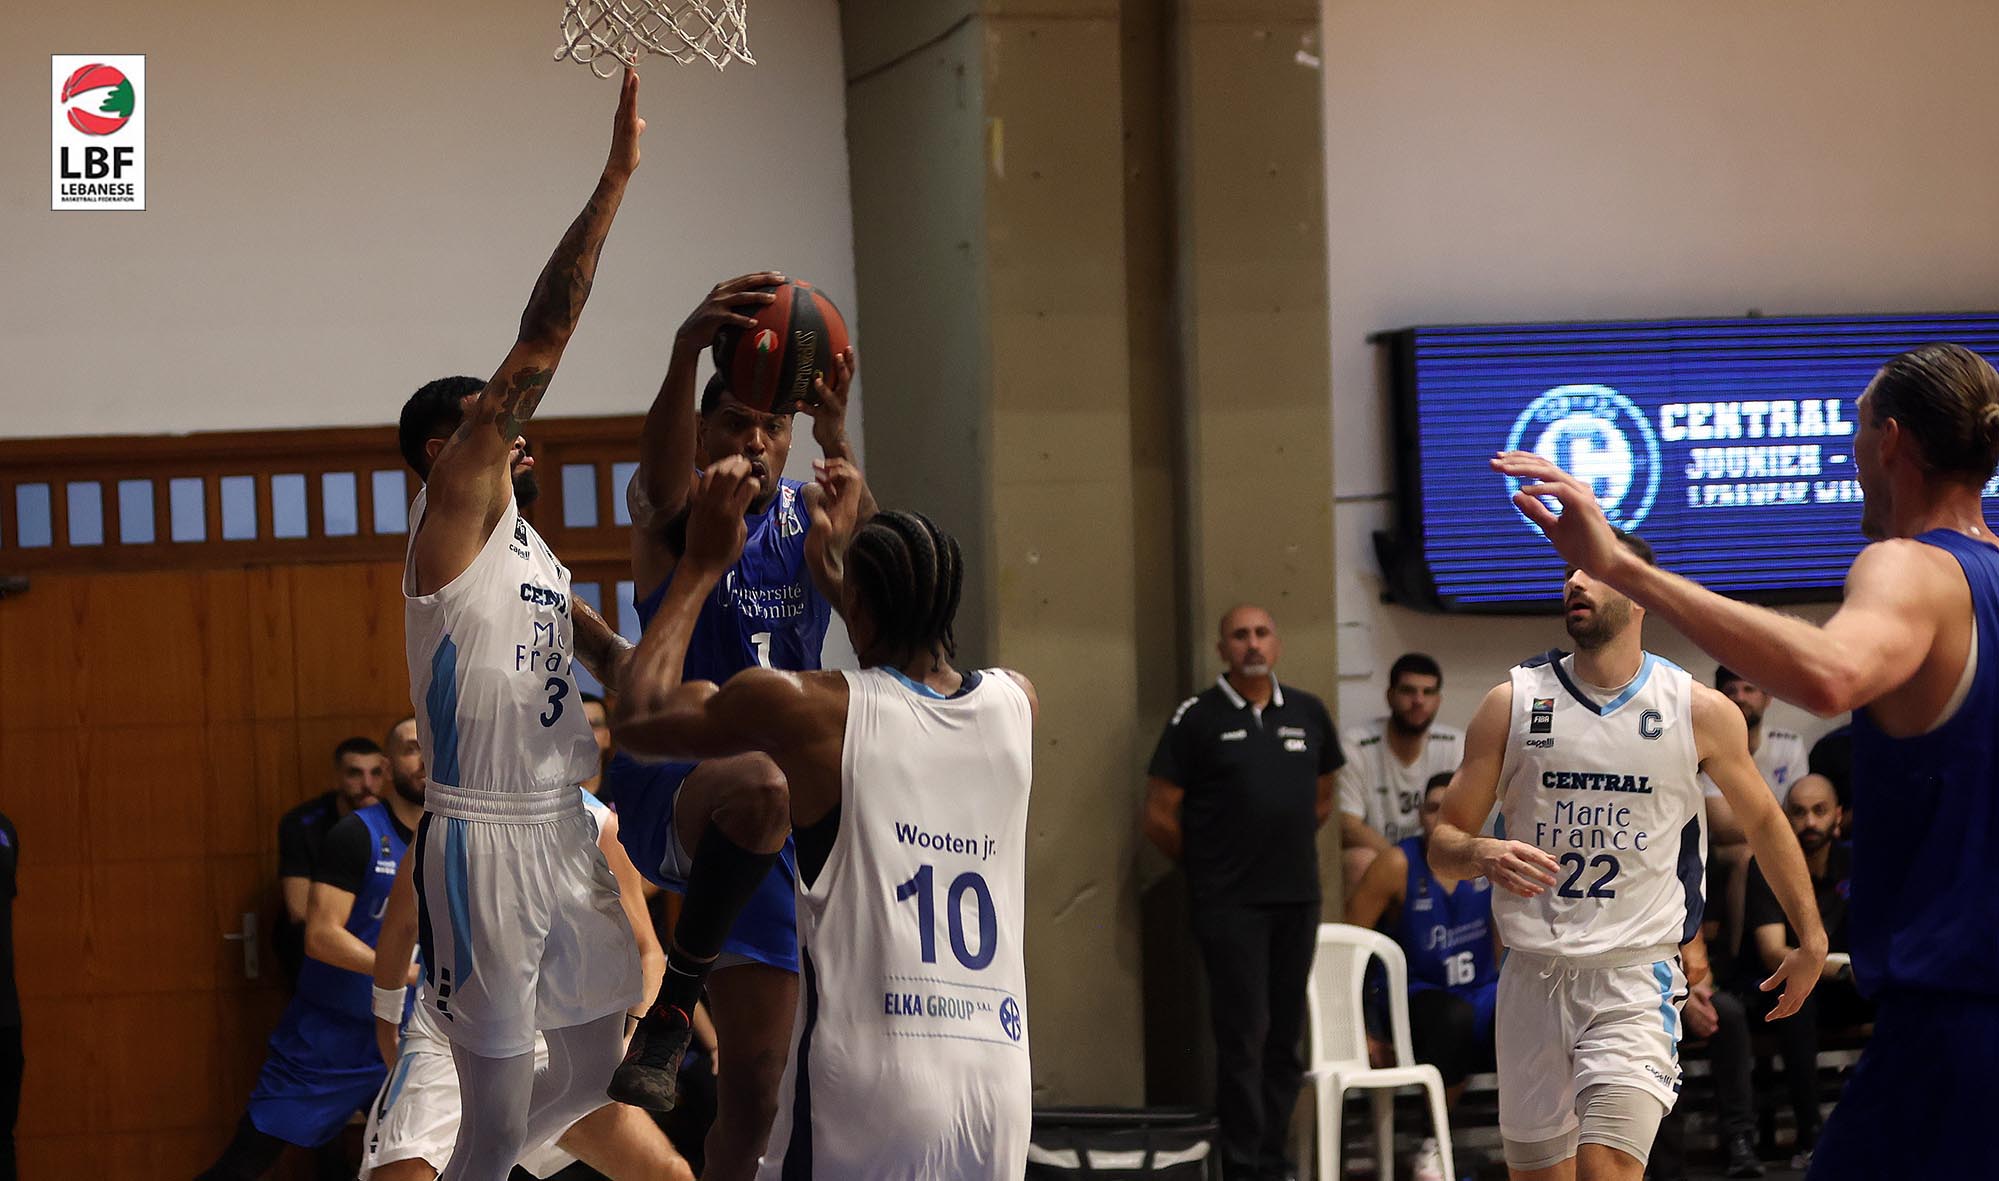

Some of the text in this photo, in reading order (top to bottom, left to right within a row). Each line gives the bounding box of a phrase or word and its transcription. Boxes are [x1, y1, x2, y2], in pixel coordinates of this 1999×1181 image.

[1660, 399, 1853, 441] CENTRAL
[540, 677, 569, 728] 3
[1639, 709, 1662, 740] C
[1542, 771, 1653, 794] CENTRAL
[1555, 800, 1631, 828] Marie
[896, 821, 996, 861] Wooten jr.
[1536, 822, 1648, 851] France
[1557, 852, 1620, 899] 22
[897, 864, 998, 971] 10
[1444, 951, 1476, 986] 16
[884, 993, 923, 1017] ELKA
[926, 994, 975, 1021] GROUP
